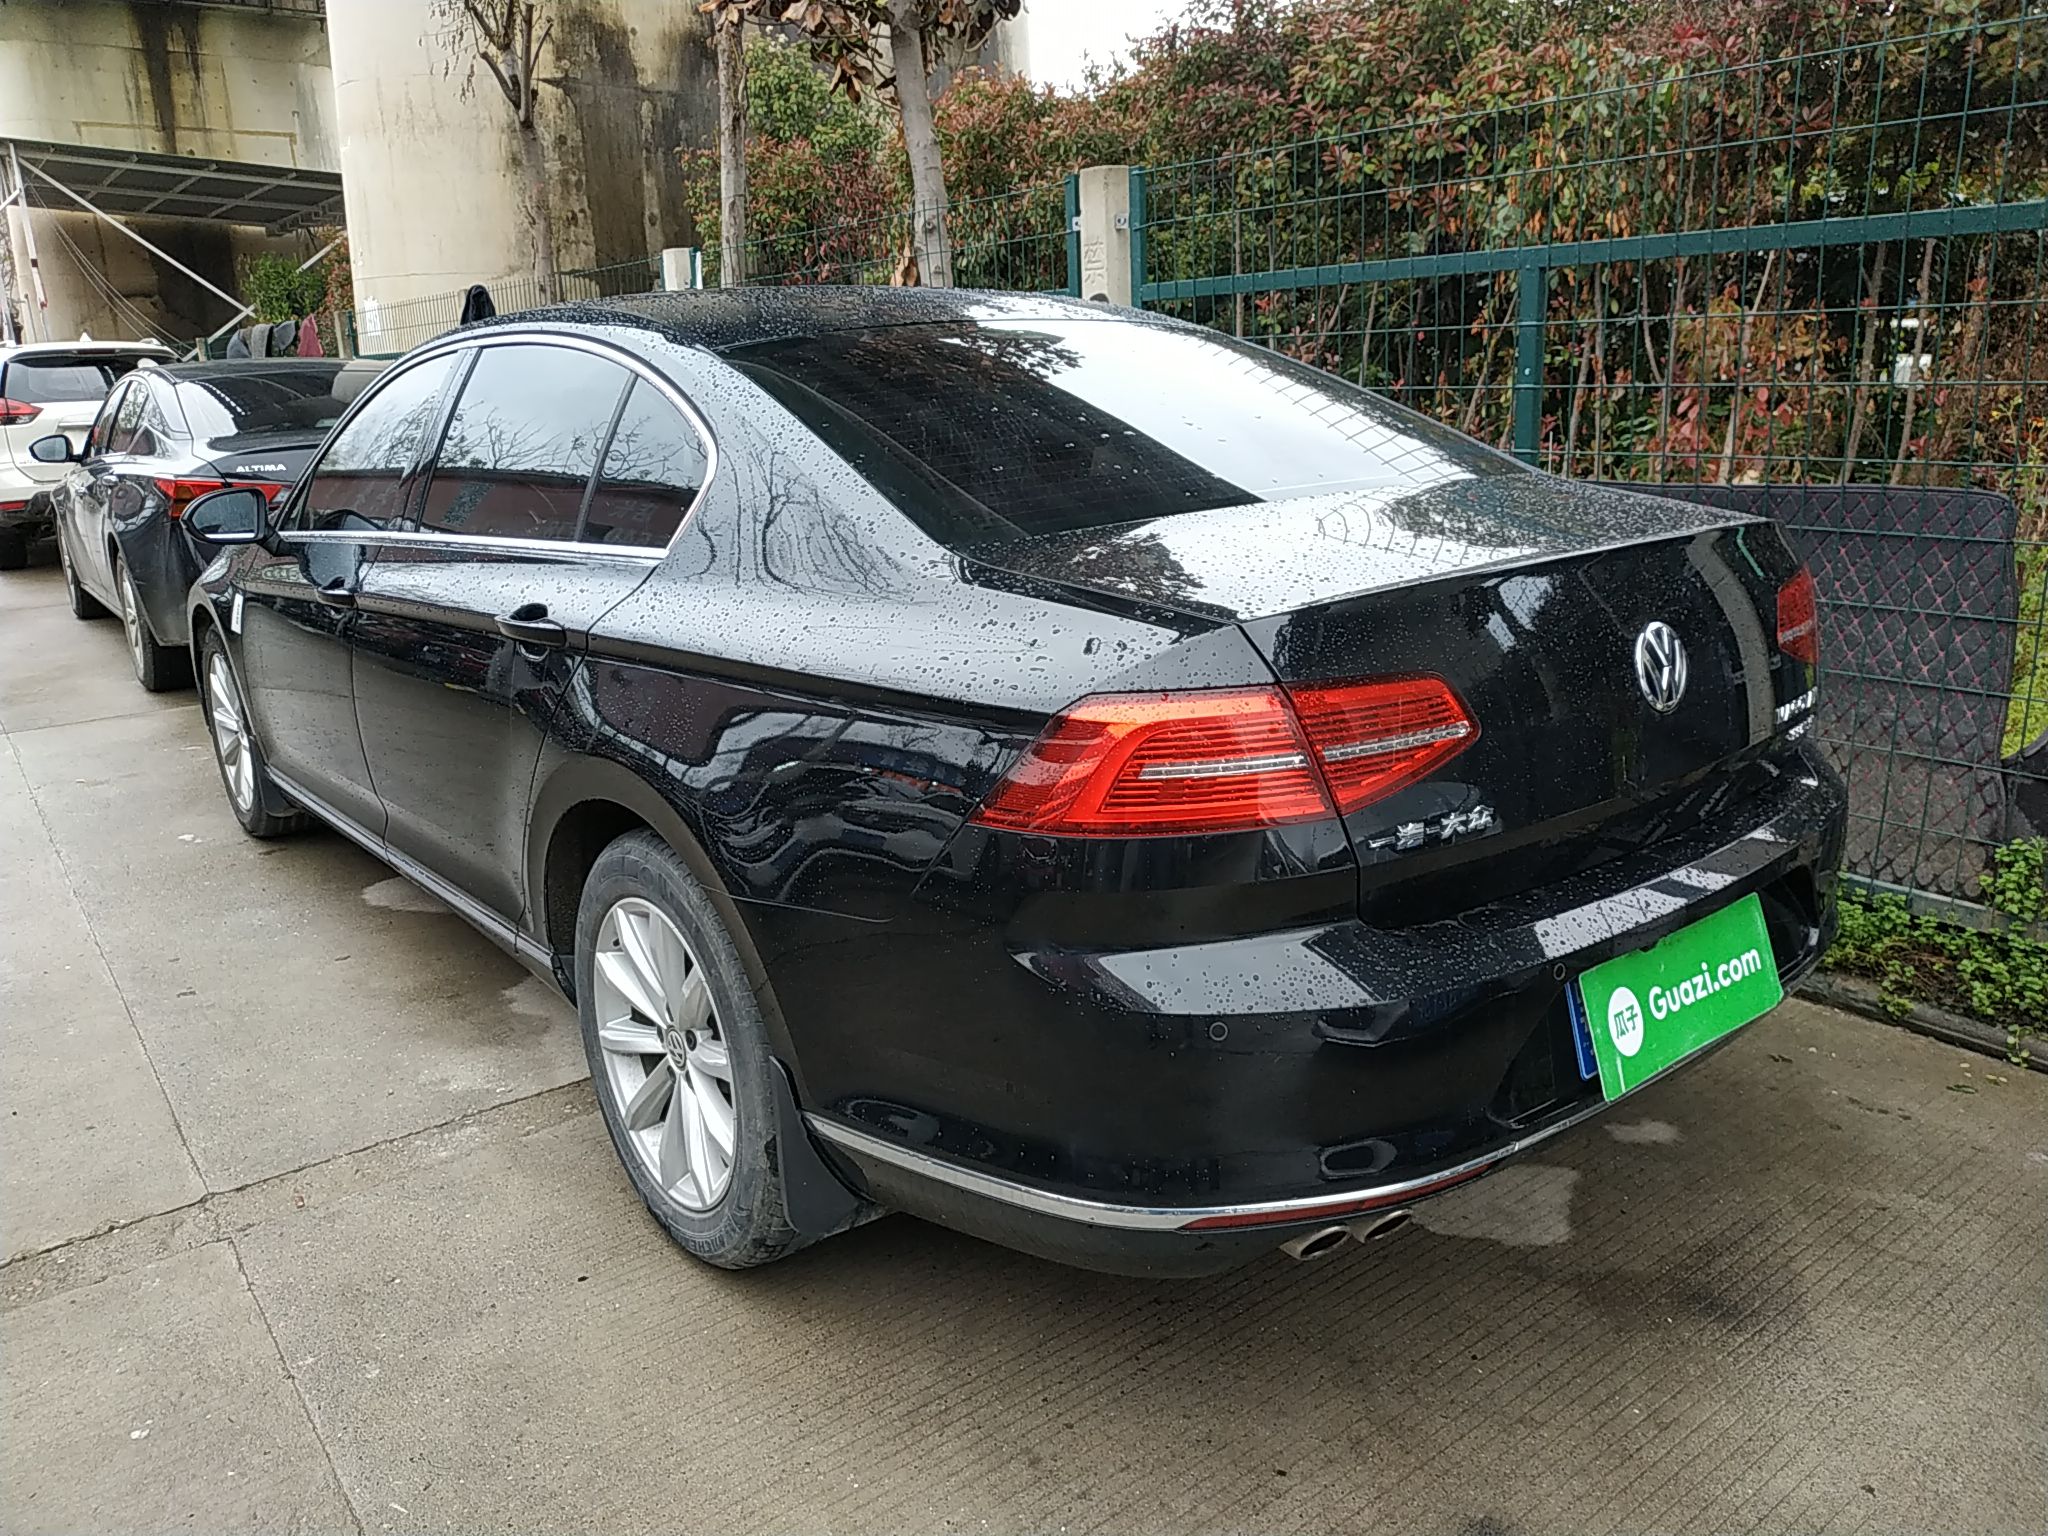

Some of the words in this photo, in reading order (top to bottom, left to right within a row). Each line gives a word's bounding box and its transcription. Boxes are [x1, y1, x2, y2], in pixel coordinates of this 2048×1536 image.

[236, 463, 287, 473] ALTIMA
[1648, 948, 1762, 1021] Guazi.com
[1613, 1004, 1638, 1040] 瓜子
